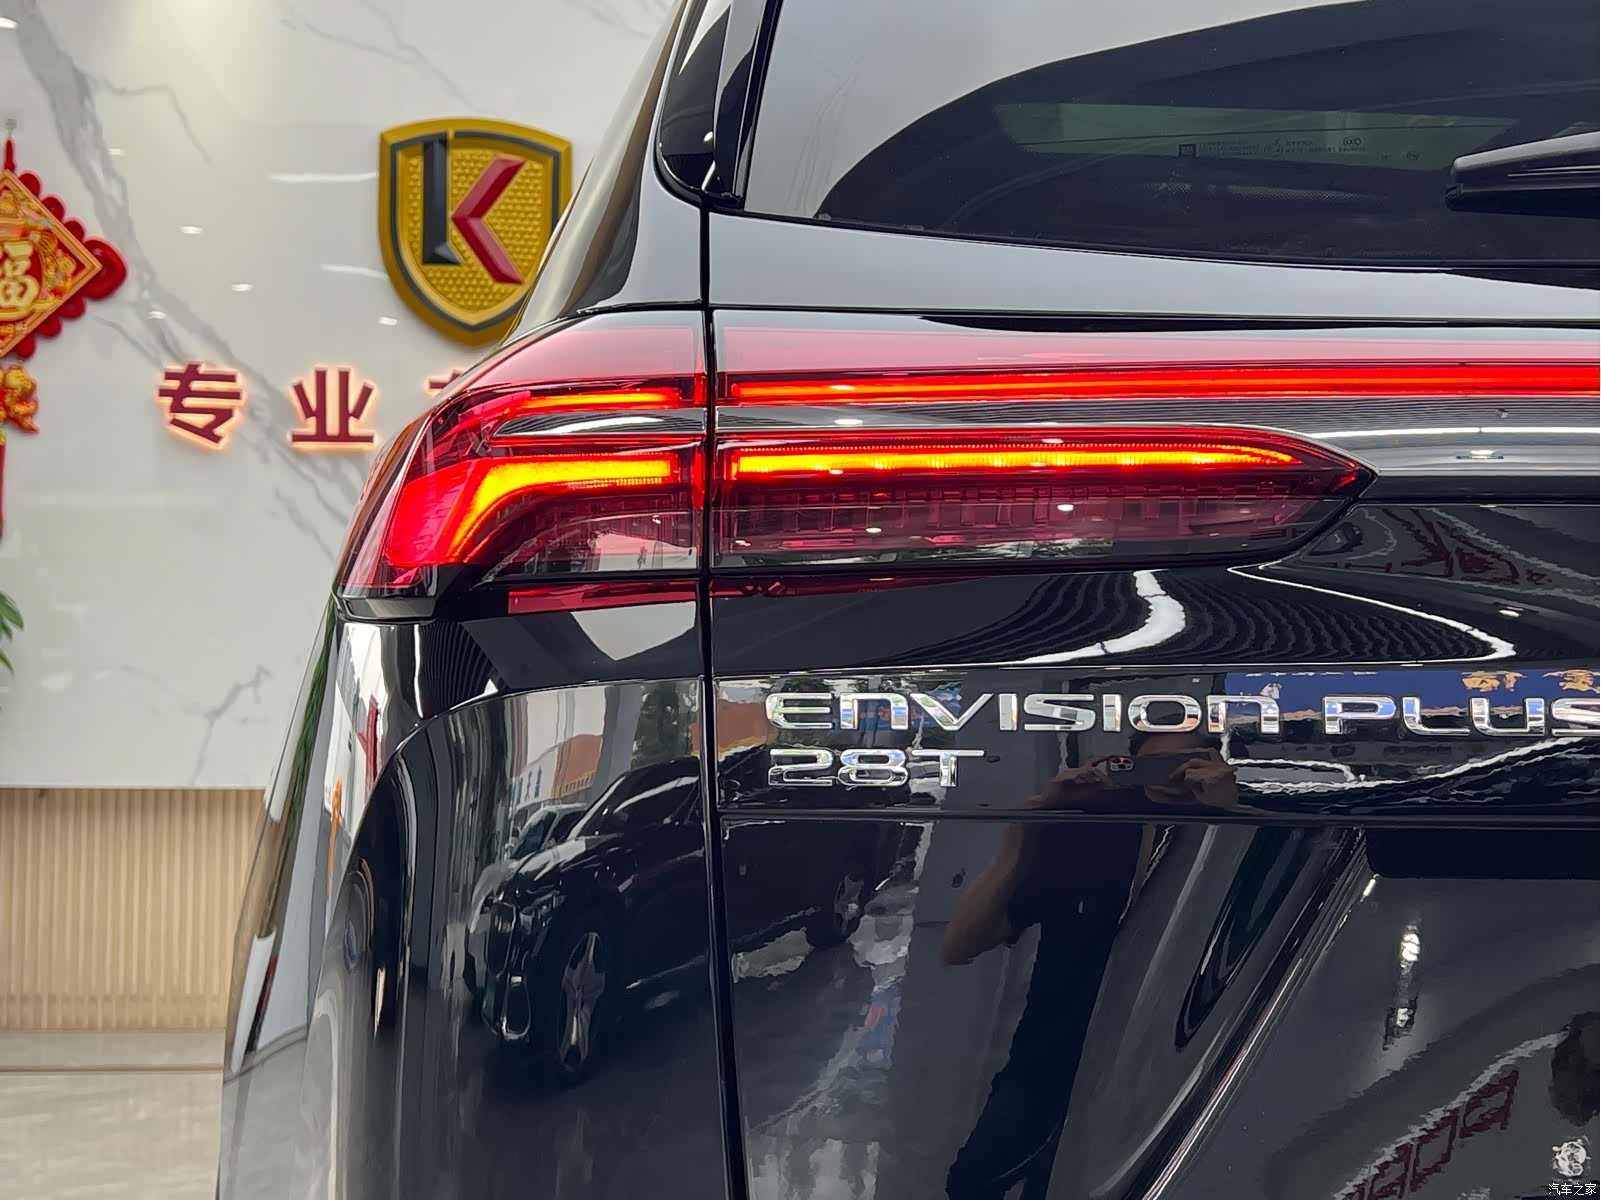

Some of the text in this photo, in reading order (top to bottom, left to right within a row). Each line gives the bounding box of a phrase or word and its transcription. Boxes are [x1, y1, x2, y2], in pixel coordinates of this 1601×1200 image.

[157, 362, 462, 447] 专业
[765, 692, 1600, 736] ENVISION PLUS
[767, 749, 985, 787] 28T
